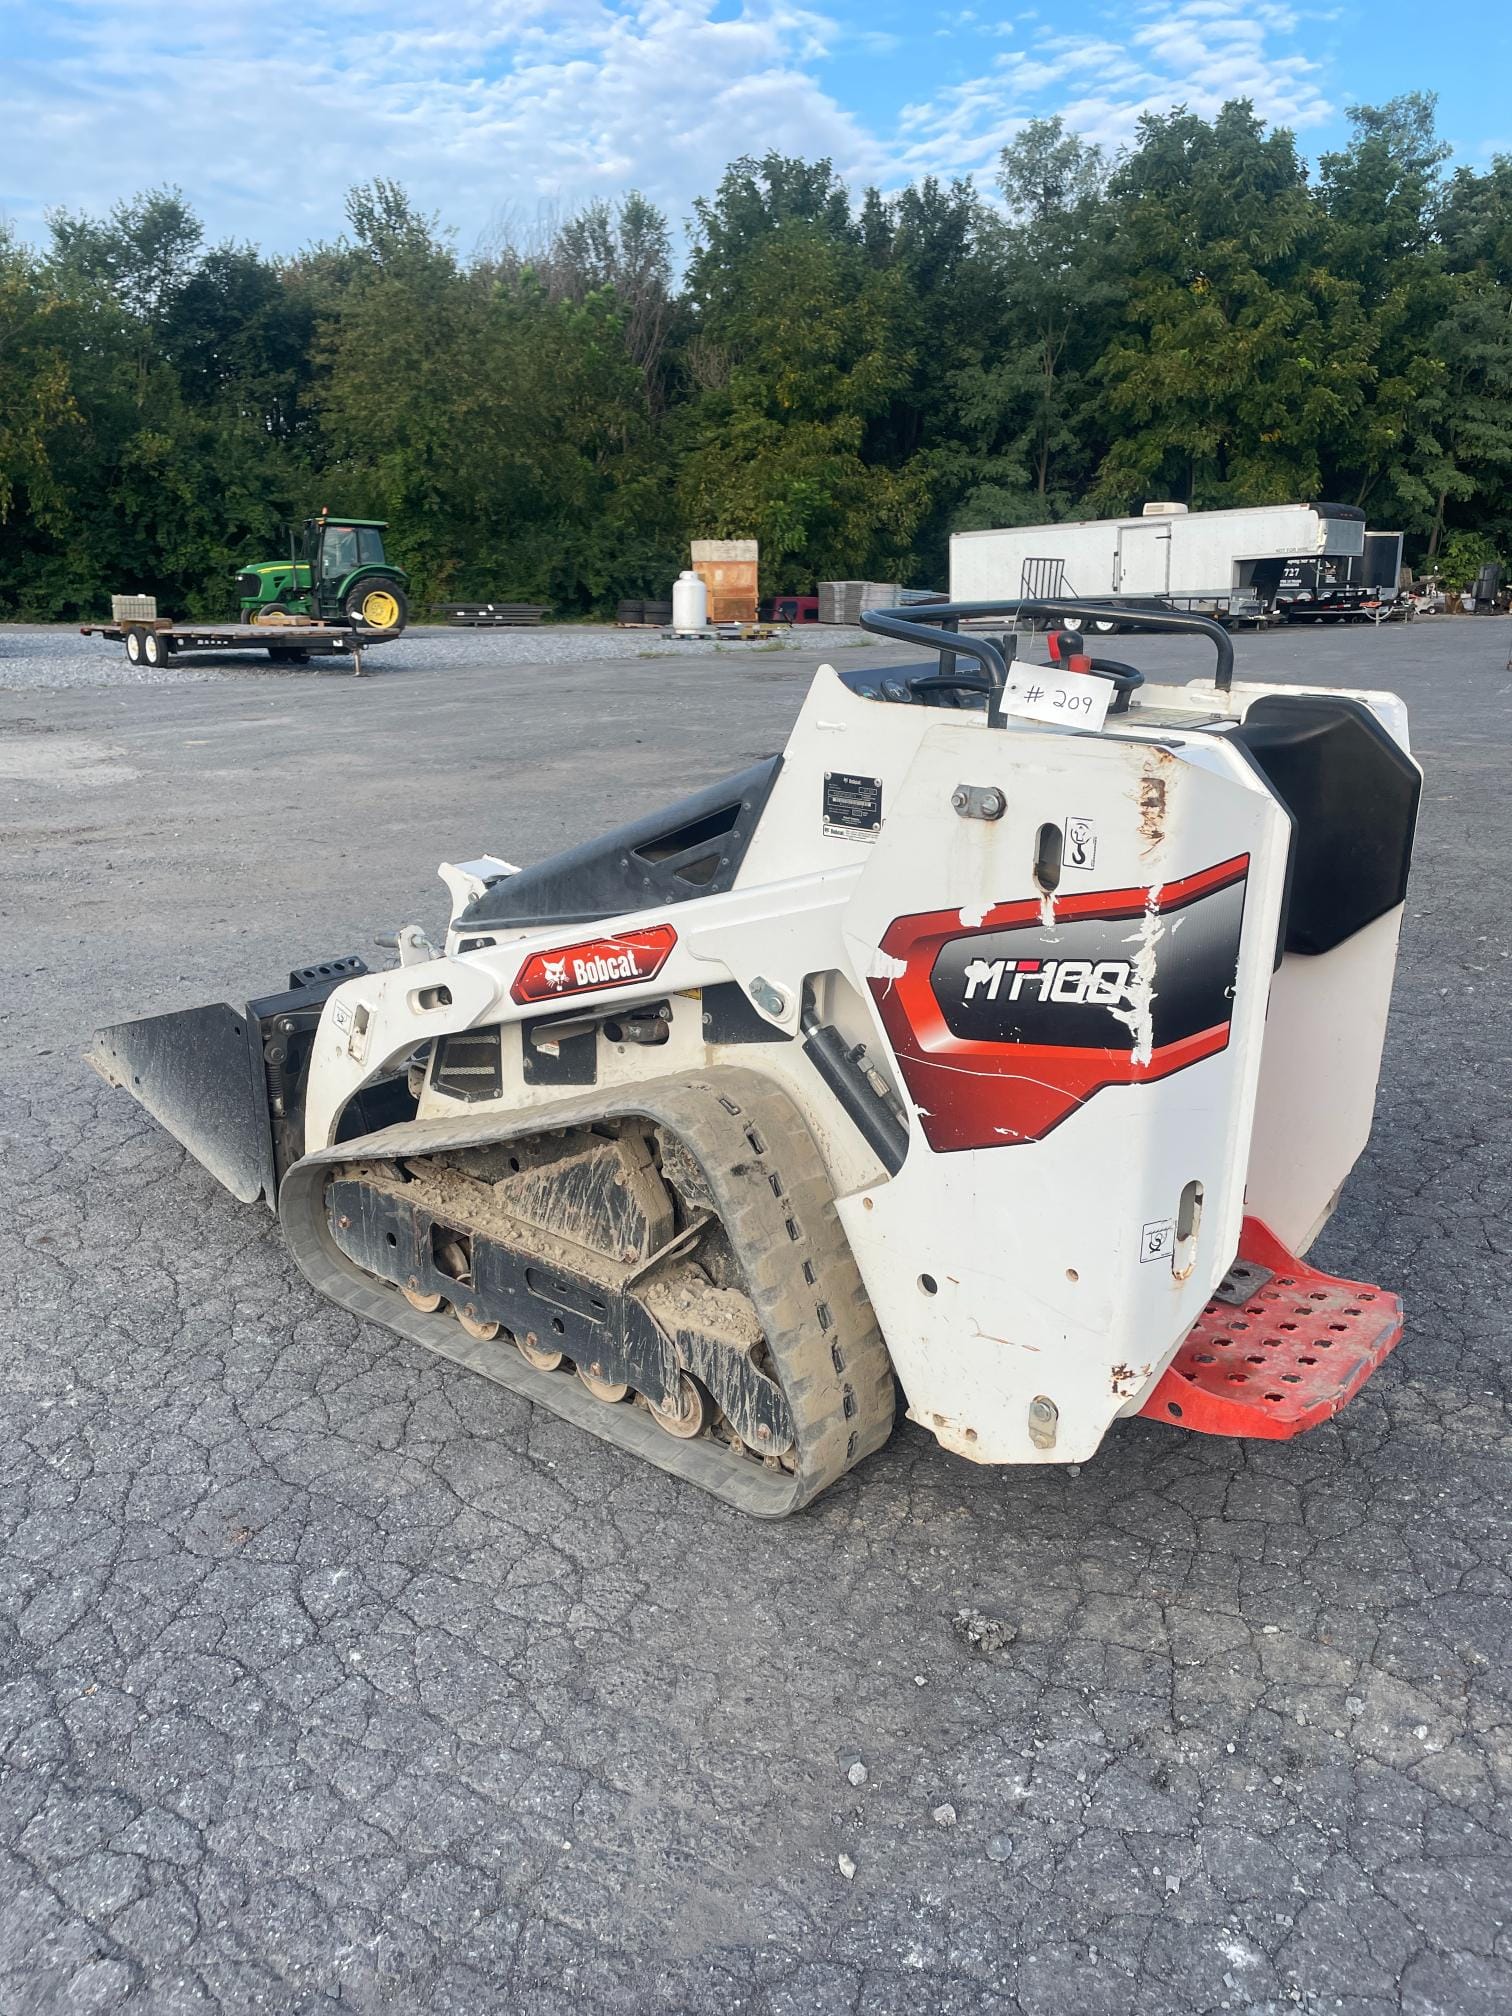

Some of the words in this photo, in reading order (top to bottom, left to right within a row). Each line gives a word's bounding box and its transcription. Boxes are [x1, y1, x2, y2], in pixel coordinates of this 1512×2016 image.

[1283, 567, 1300, 577] 727
[1023, 685, 1045, 704] #
[1052, 689, 1093, 714] 209
[572, 949, 639, 986] Bobcat
[964, 958, 1134, 1004] MT100
